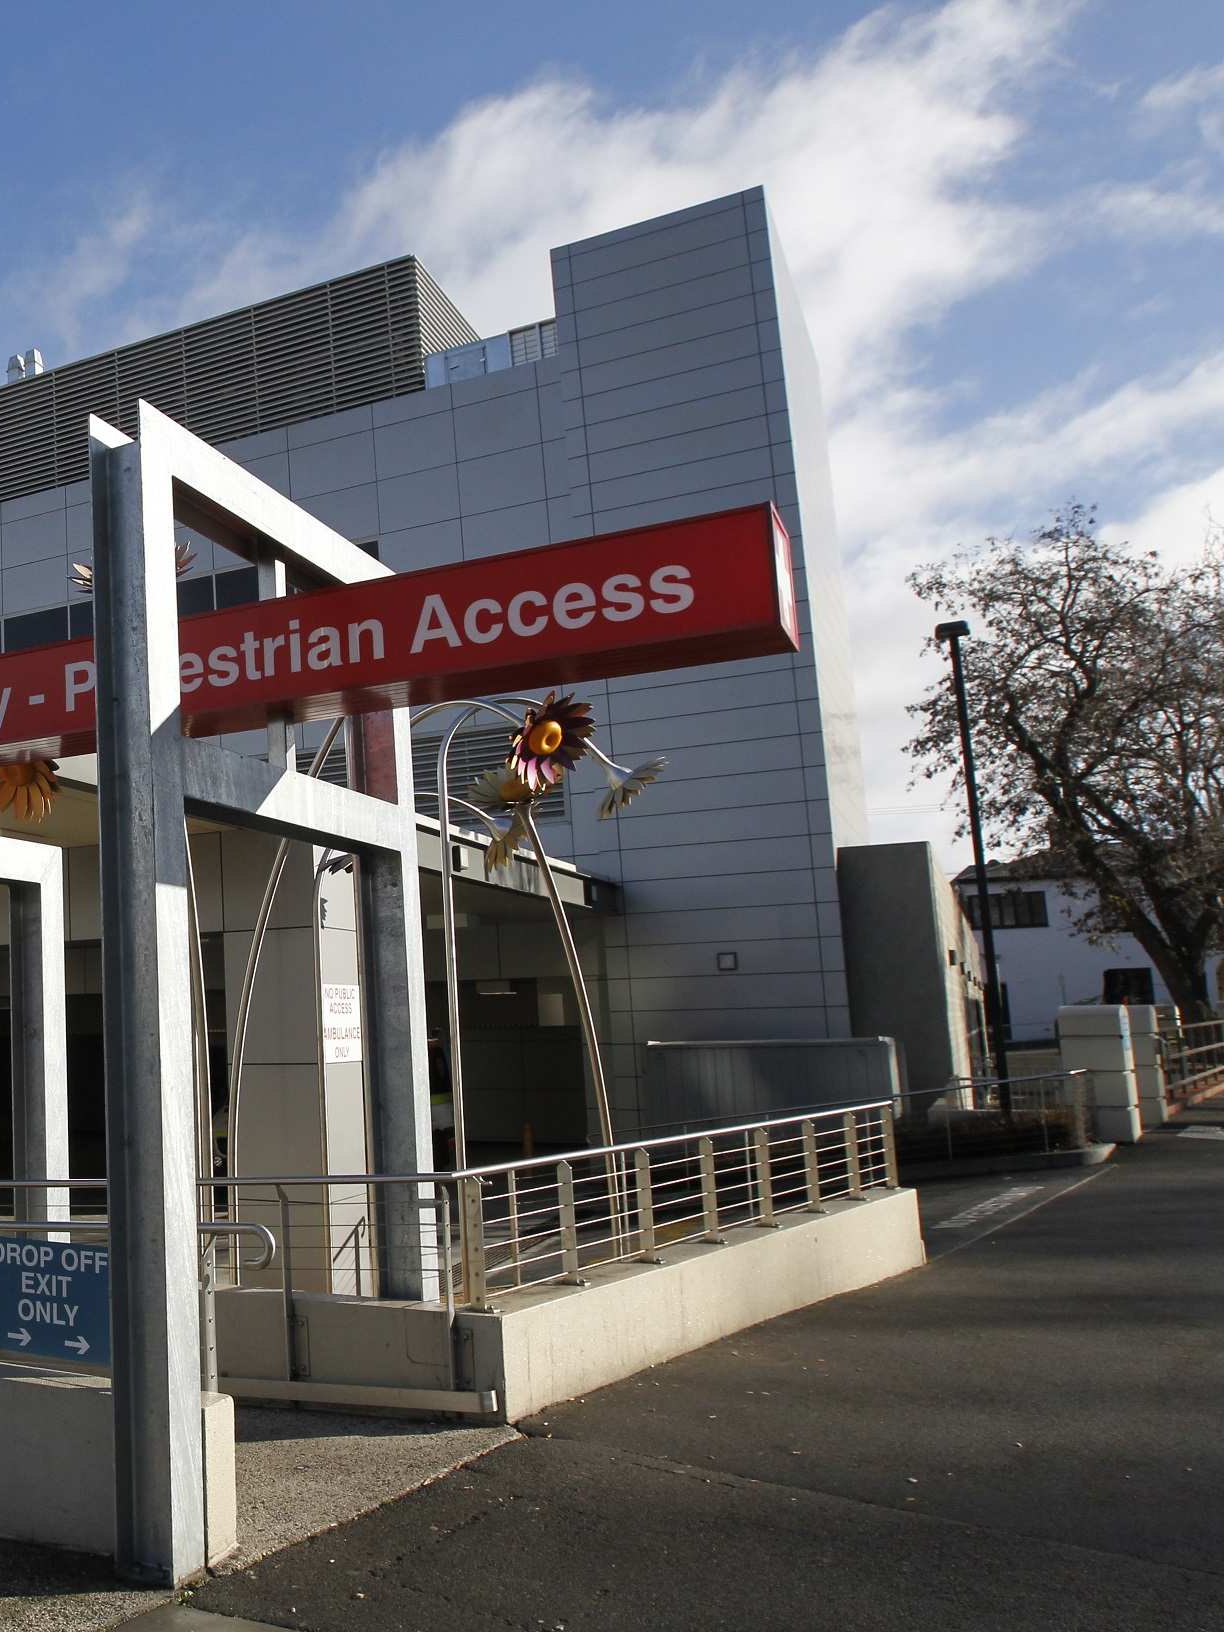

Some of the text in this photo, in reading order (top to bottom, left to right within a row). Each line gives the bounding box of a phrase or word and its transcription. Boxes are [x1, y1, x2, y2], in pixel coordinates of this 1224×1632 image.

[65, 616, 384, 712] Pestrian
[410, 565, 695, 653] Access
[325, 988, 355, 999] NO PUBLIC
[329, 1002, 352, 1014] ACCESS
[324, 1027, 360, 1040] AMBULANCE
[335, 1046, 349, 1058] ONLY
[60, 1248, 109, 1274] OFF
[21, 1271, 72, 1298] EXIT
[17, 1298, 79, 1327] ONLY
